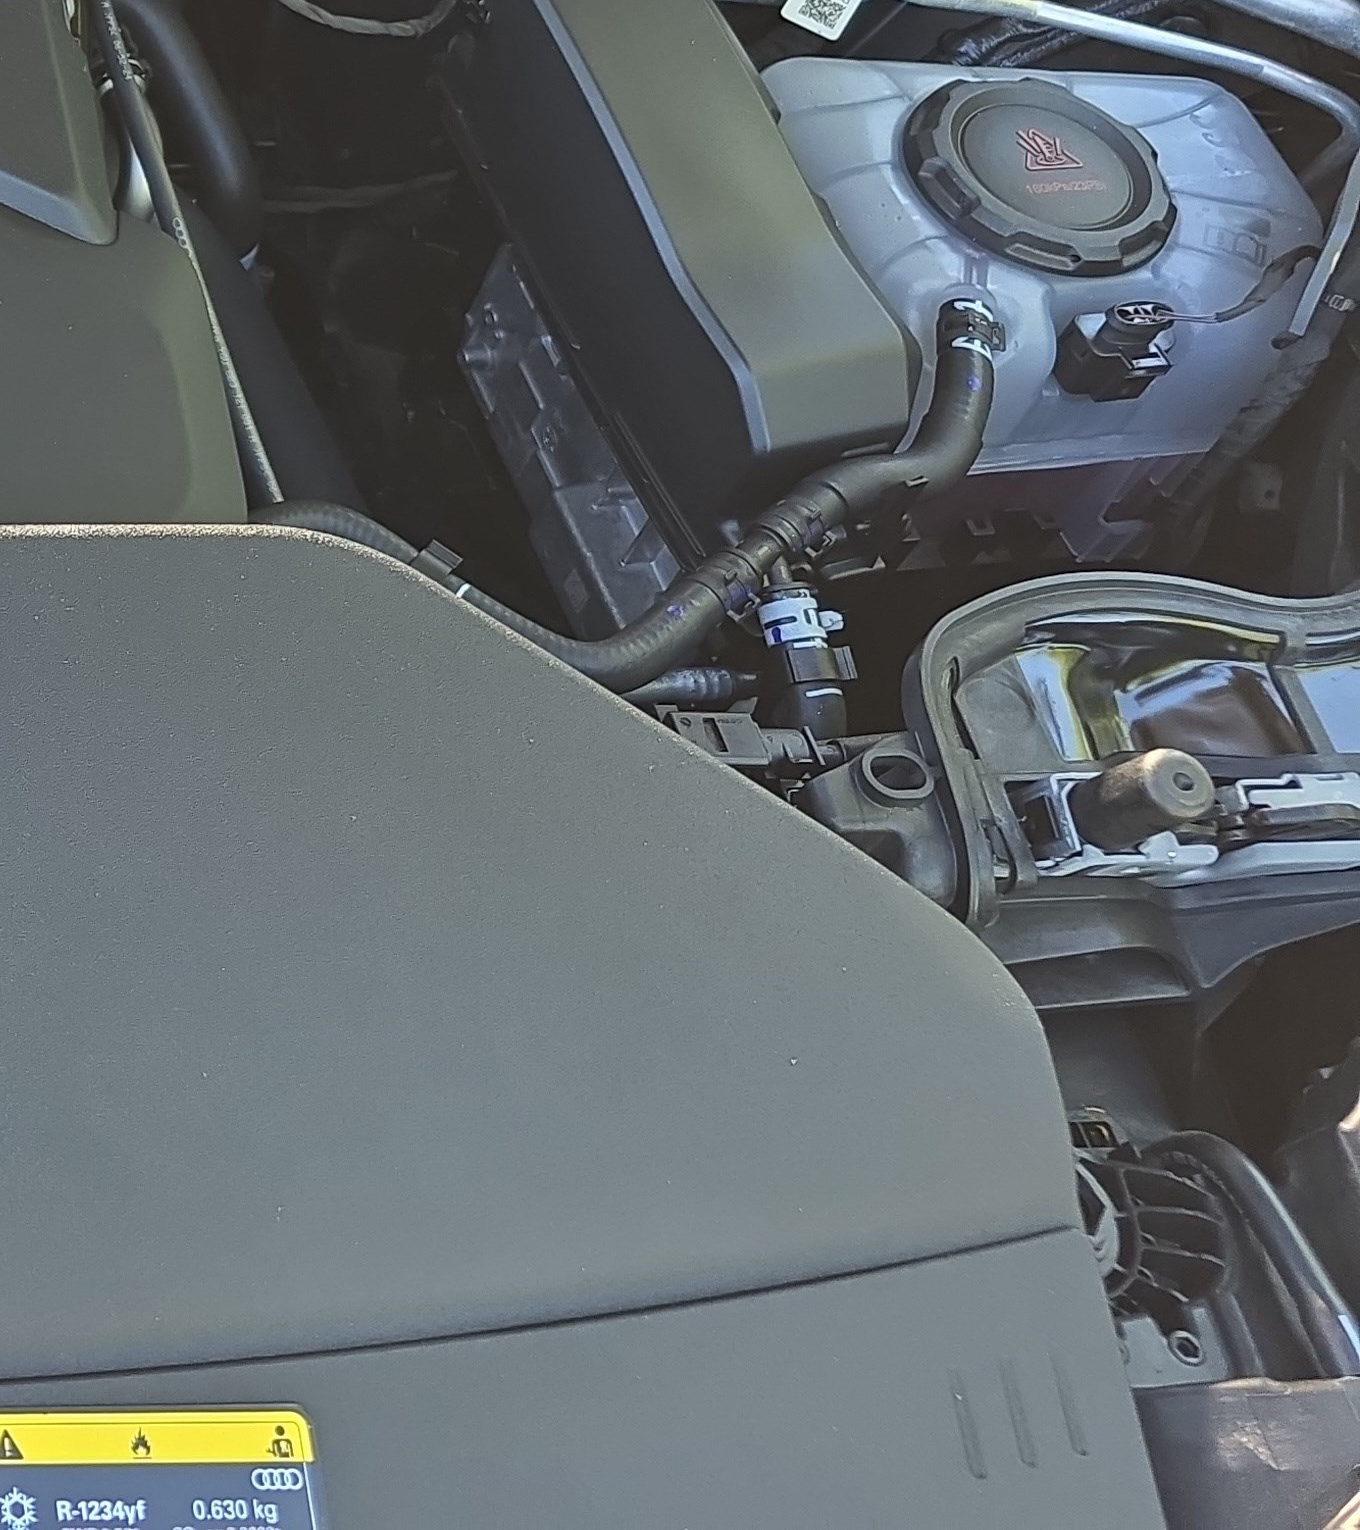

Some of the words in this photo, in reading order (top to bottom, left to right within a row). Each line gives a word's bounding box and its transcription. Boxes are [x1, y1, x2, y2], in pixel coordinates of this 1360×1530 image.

[56, 1499, 147, 1525] R-1234yf
[192, 1499, 248, 1520] 0.630
[253, 1499, 278, 1523] kg
